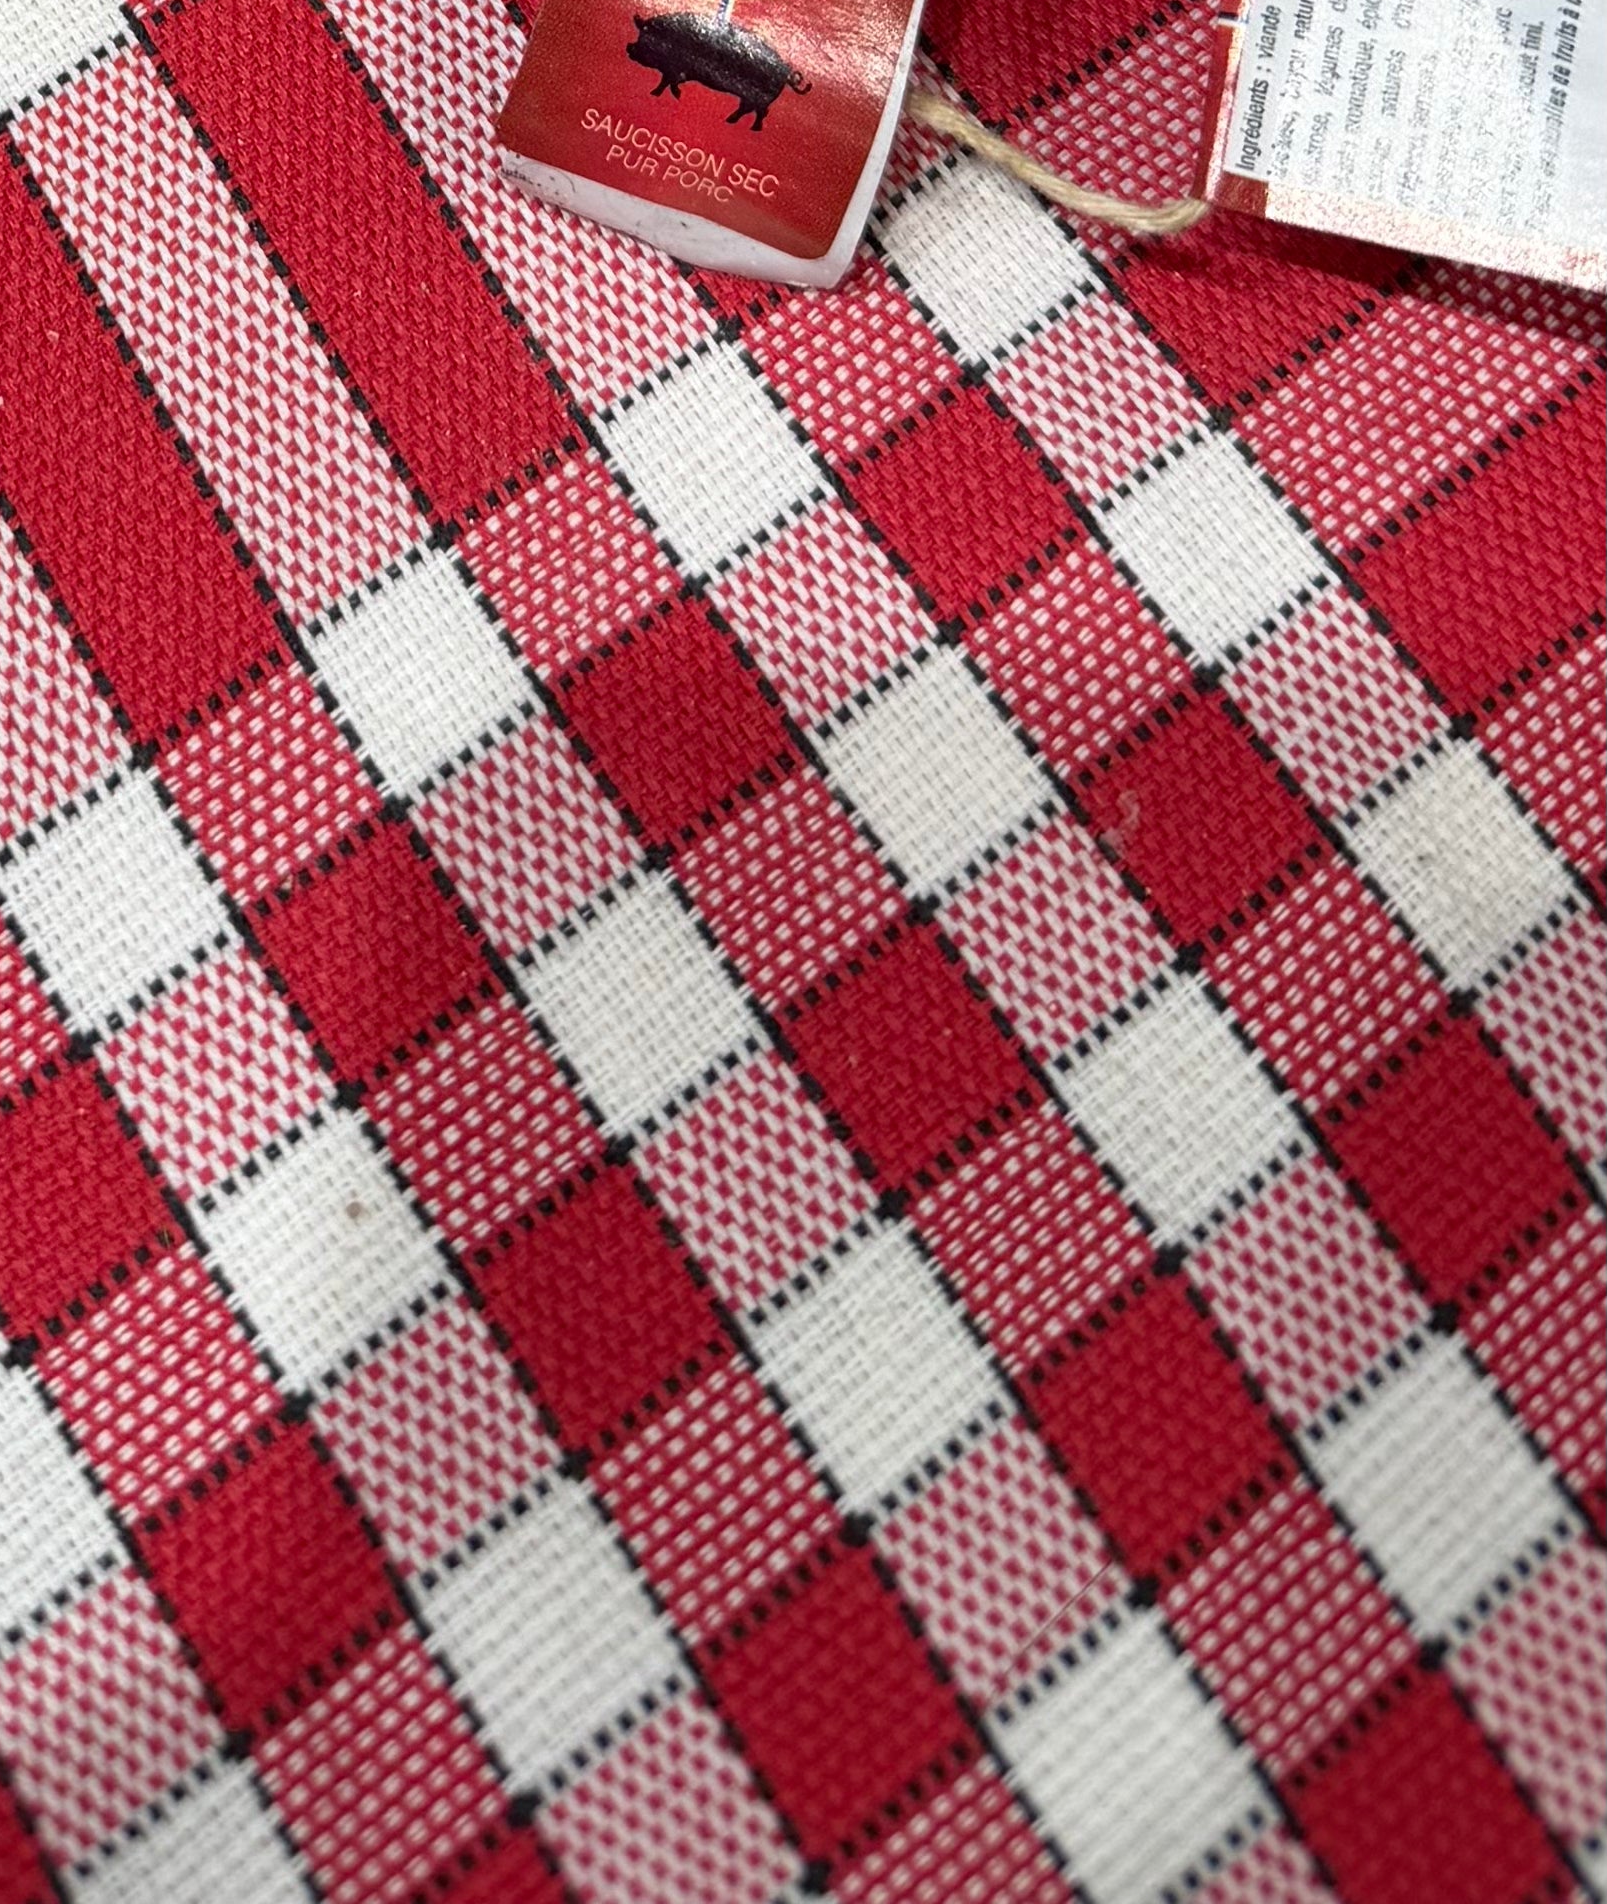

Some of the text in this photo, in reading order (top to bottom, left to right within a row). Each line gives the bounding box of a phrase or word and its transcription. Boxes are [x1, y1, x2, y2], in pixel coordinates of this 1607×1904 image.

[1521, 18, 1545, 50] fini.
[1559, 8, 1580, 19] à
[1554, 20, 1579, 62] fruits
[1236, 77, 1273, 171] Ingrédients
[1255, 4, 1282, 60] viande
[1548, 64, 1572, 85] de
[580, 108, 726, 178] SAUCISSON
[727, 162, 780, 198] SEC
[605, 144, 734, 202] PUR PORC
